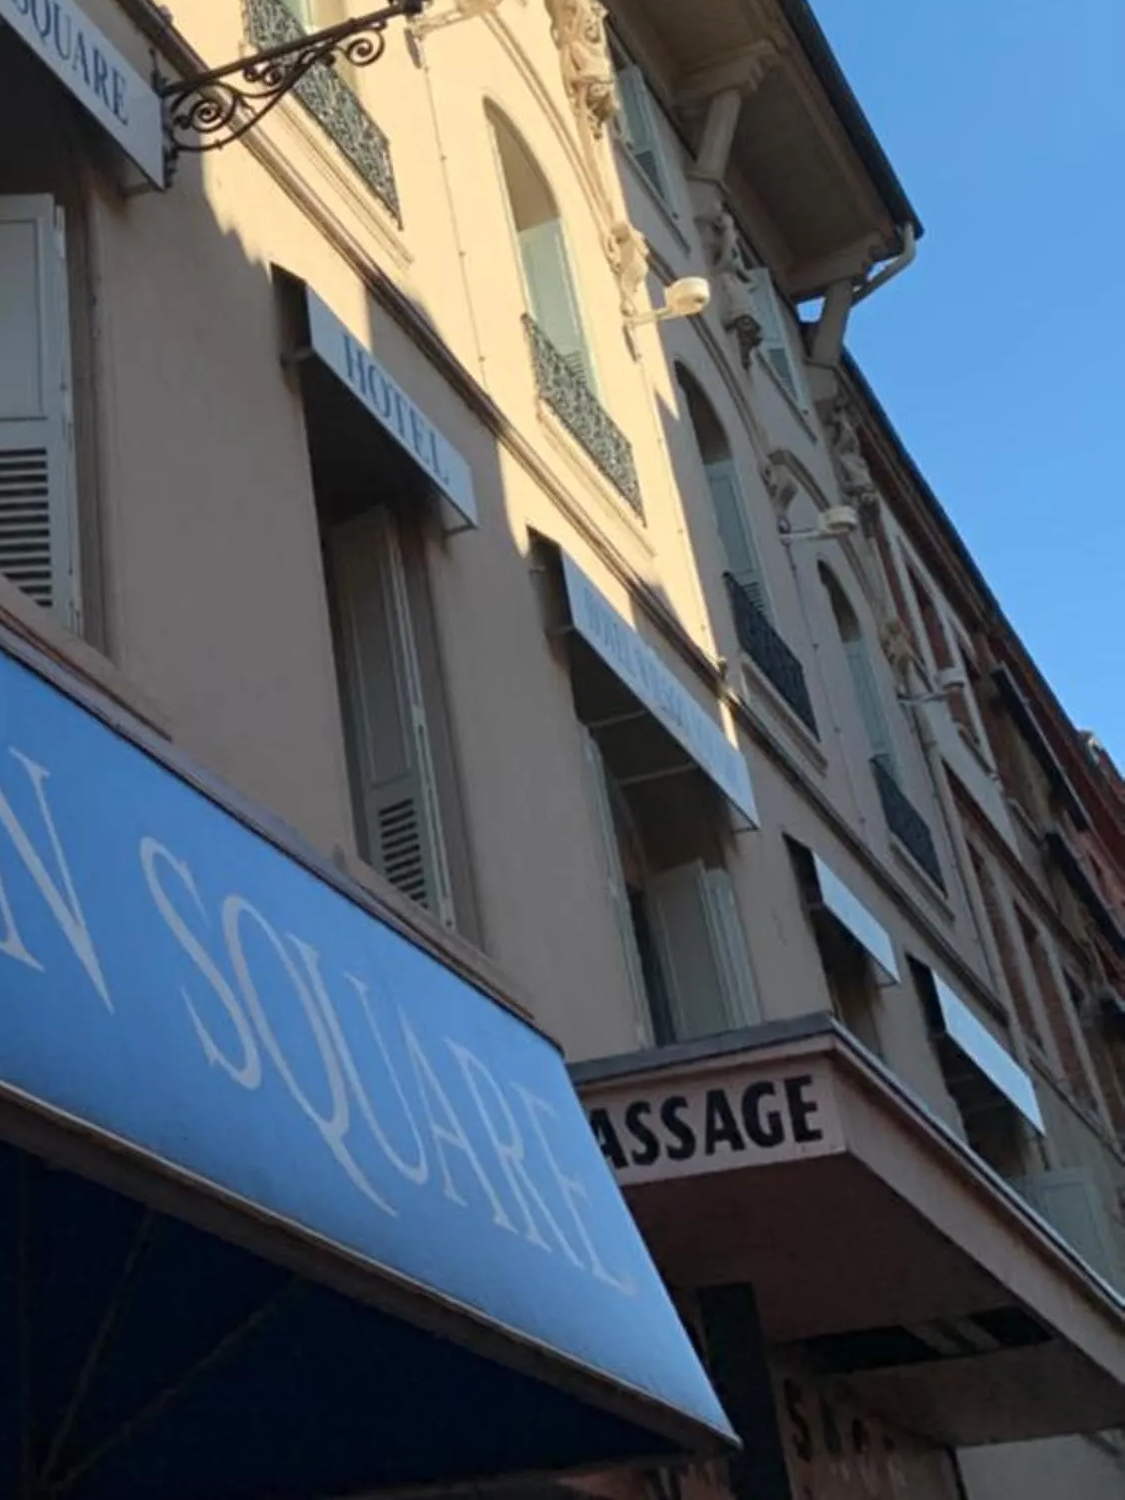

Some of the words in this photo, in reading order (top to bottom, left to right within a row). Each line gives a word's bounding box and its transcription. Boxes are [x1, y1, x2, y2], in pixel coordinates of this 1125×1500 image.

[343, 331, 450, 486] HOTEL
[139, 836, 639, 1297] SQUARE
[588, 1075, 823, 1170] ASSAGE
